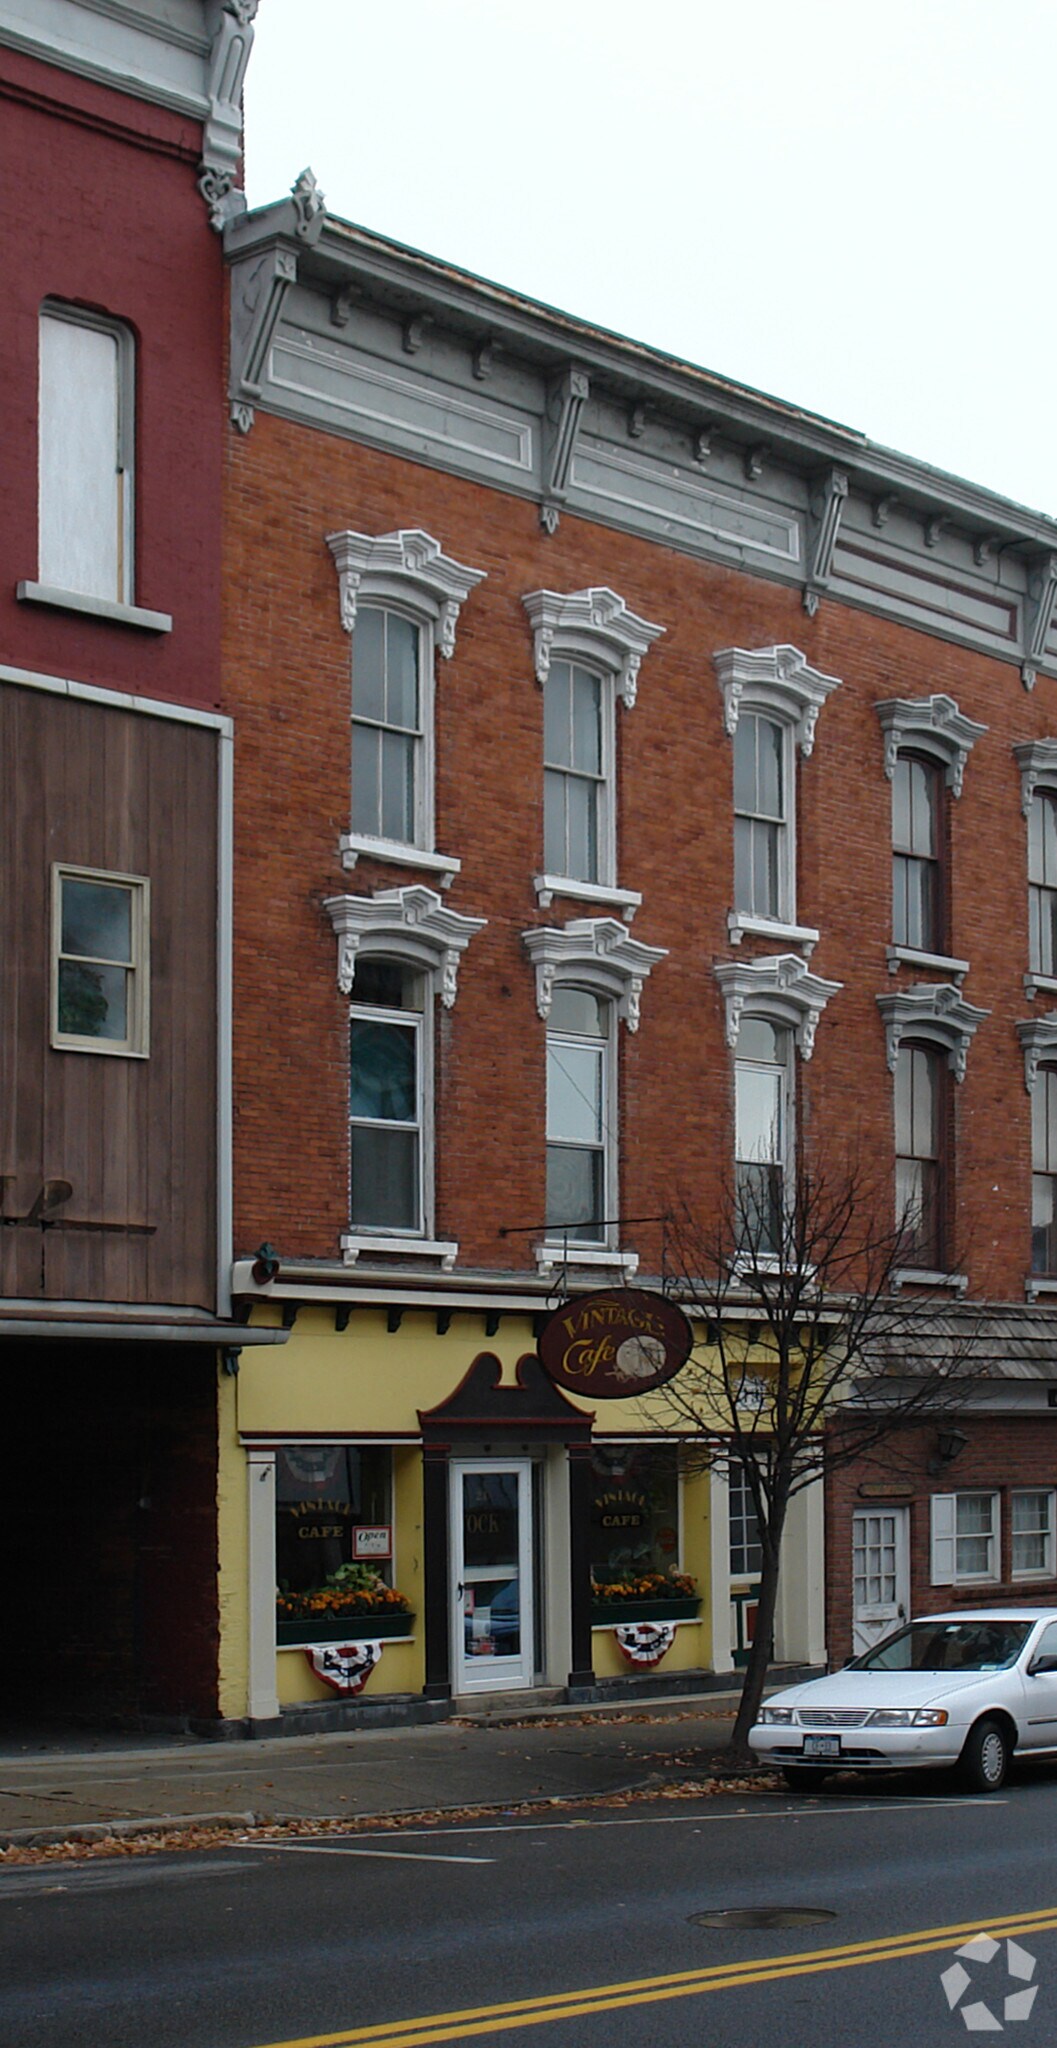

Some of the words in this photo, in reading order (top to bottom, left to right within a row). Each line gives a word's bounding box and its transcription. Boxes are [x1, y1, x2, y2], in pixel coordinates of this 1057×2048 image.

[563, 1334, 617, 1377] Cafe
[602, 1515, 640, 1527] CAFE
[298, 1526, 344, 1539] CAFE
[358, 1530, 387, 1543] Open
